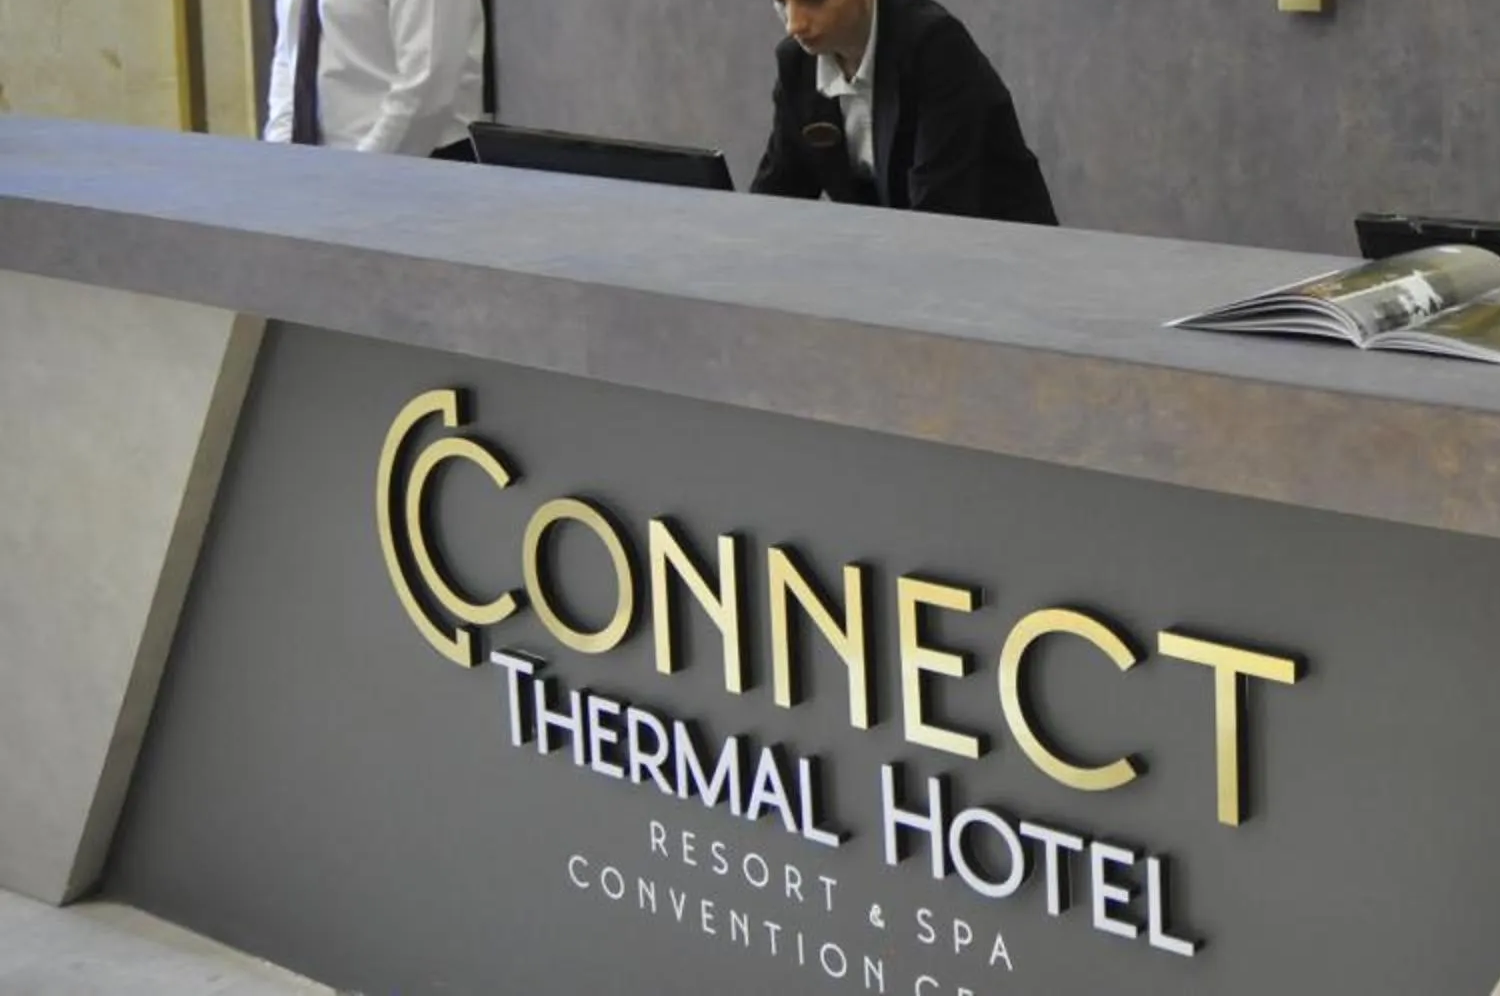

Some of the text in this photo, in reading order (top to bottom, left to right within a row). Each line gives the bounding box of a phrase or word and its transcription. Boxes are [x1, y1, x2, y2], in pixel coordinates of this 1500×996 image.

[376, 389, 1297, 827] CONNECT
[490, 650, 1196, 957] THERMAL HOTEL
[649, 820, 1013, 971] RESORT & SPA
[567, 854, 885, 994] CONVENTION
